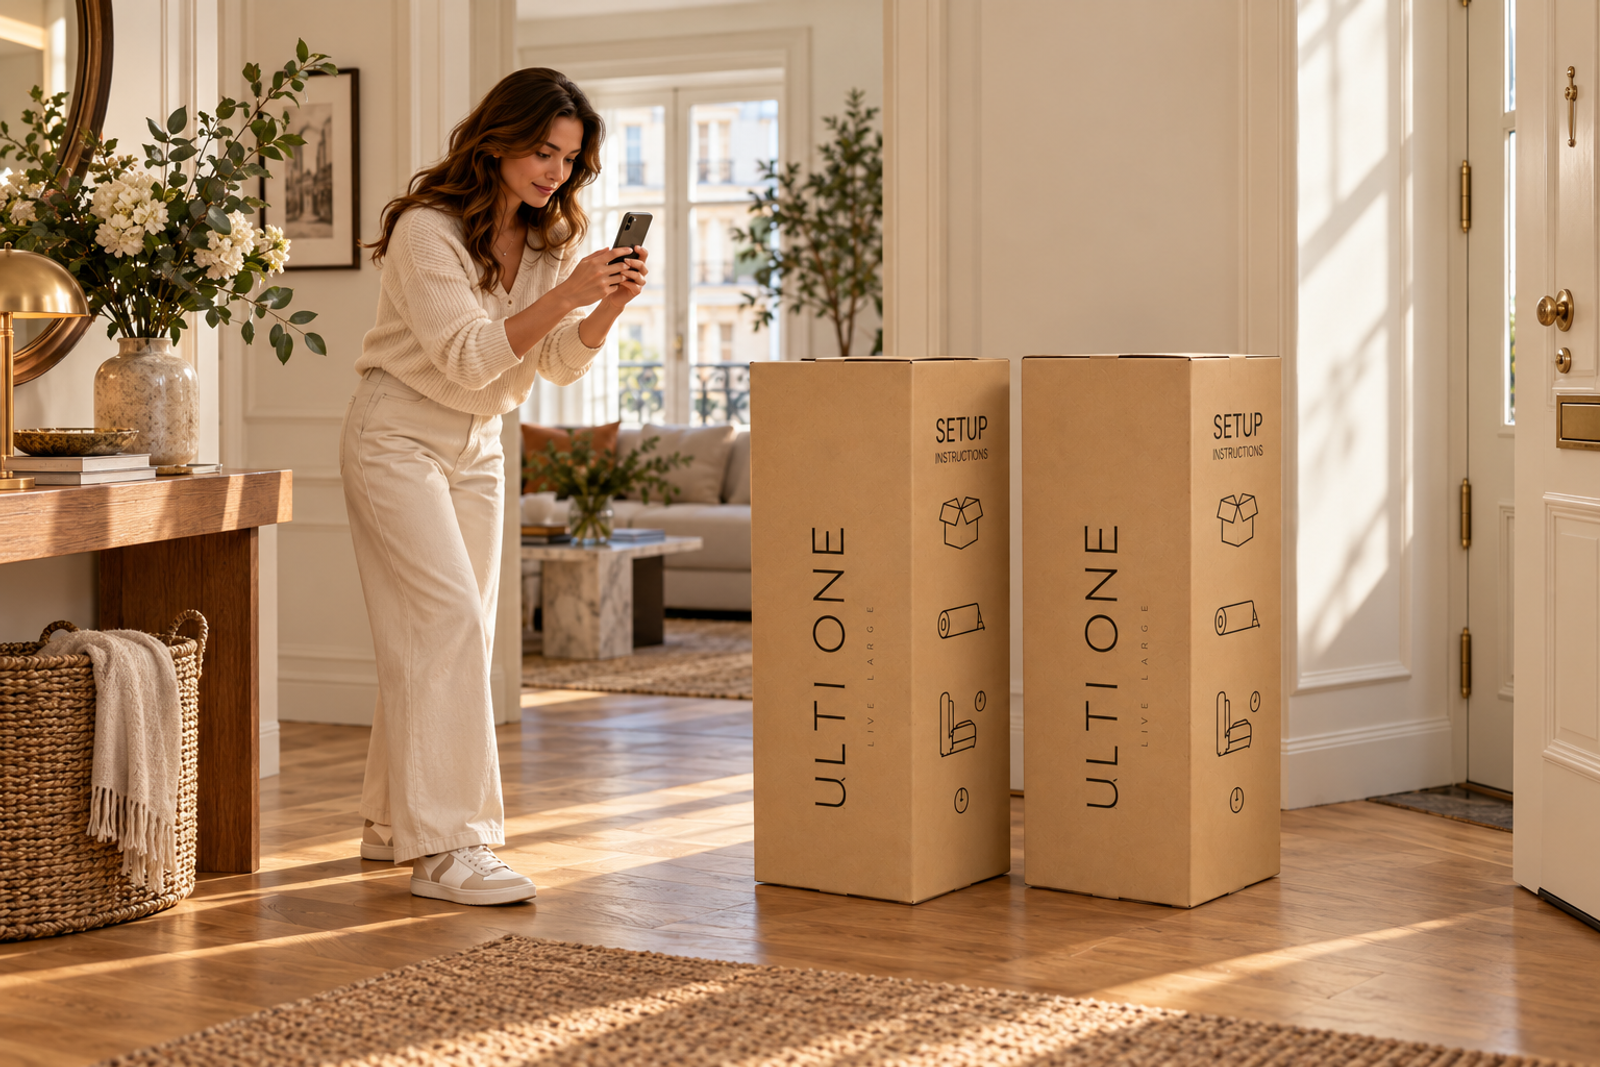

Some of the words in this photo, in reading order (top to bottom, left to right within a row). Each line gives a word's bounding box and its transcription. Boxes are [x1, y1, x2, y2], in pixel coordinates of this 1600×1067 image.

[935, 415, 988, 444] SETUP
[1213, 412, 1263, 440] SETUP
[934, 447, 989, 465] INSTRUCTIONS
[1212, 444, 1264, 461] INSTRUCTIONS
[866, 606, 875, 681] LARGE
[1140, 605, 1149, 681] LARGE
[866, 703, 875, 748] LIVE
[1140, 703, 1149, 748] LIVE
